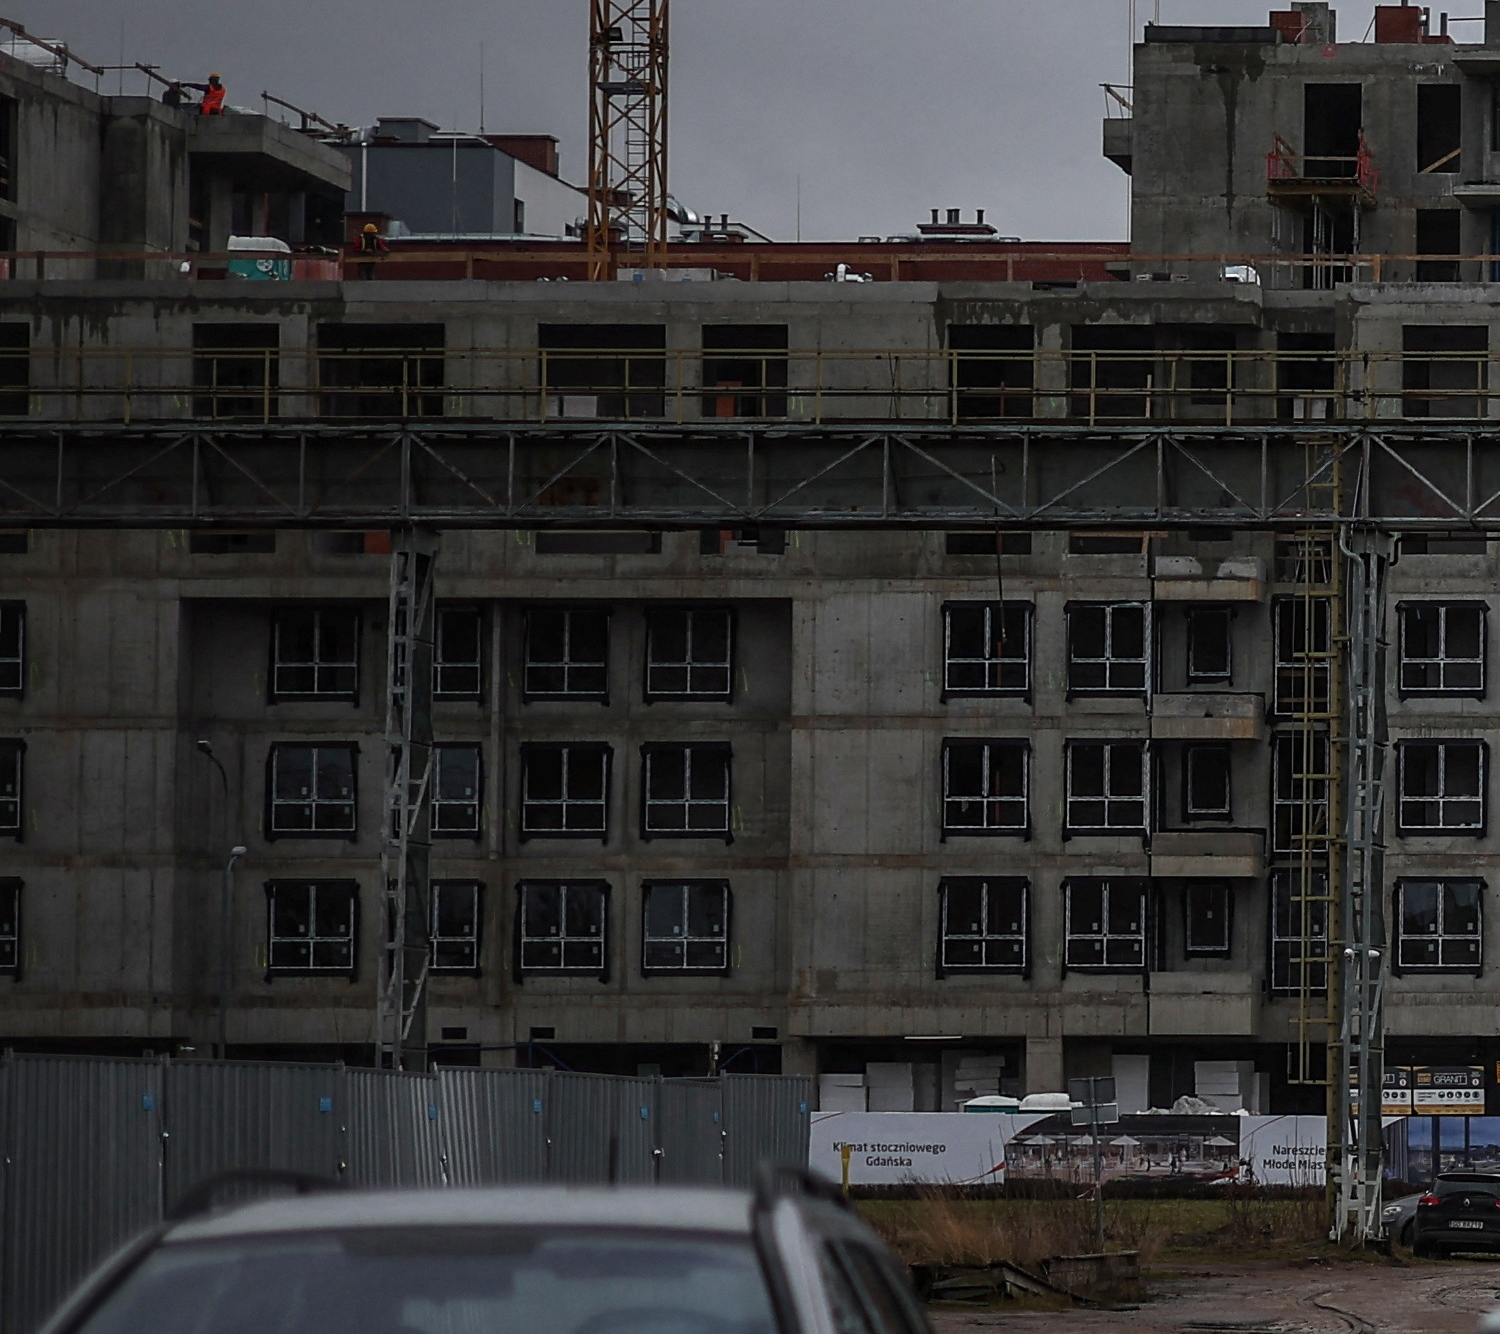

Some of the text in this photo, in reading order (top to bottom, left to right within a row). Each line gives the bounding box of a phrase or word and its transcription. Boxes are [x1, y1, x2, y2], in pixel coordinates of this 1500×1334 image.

[1434, 1075, 1466, 1084] GRANIT
[871, 1142, 946, 1155] stoczniowego
[1272, 1145, 1326, 1155] Nareszcie
[866, 1155, 913, 1167] Gdańska
[1263, 1158, 1296, 1170] Młode
